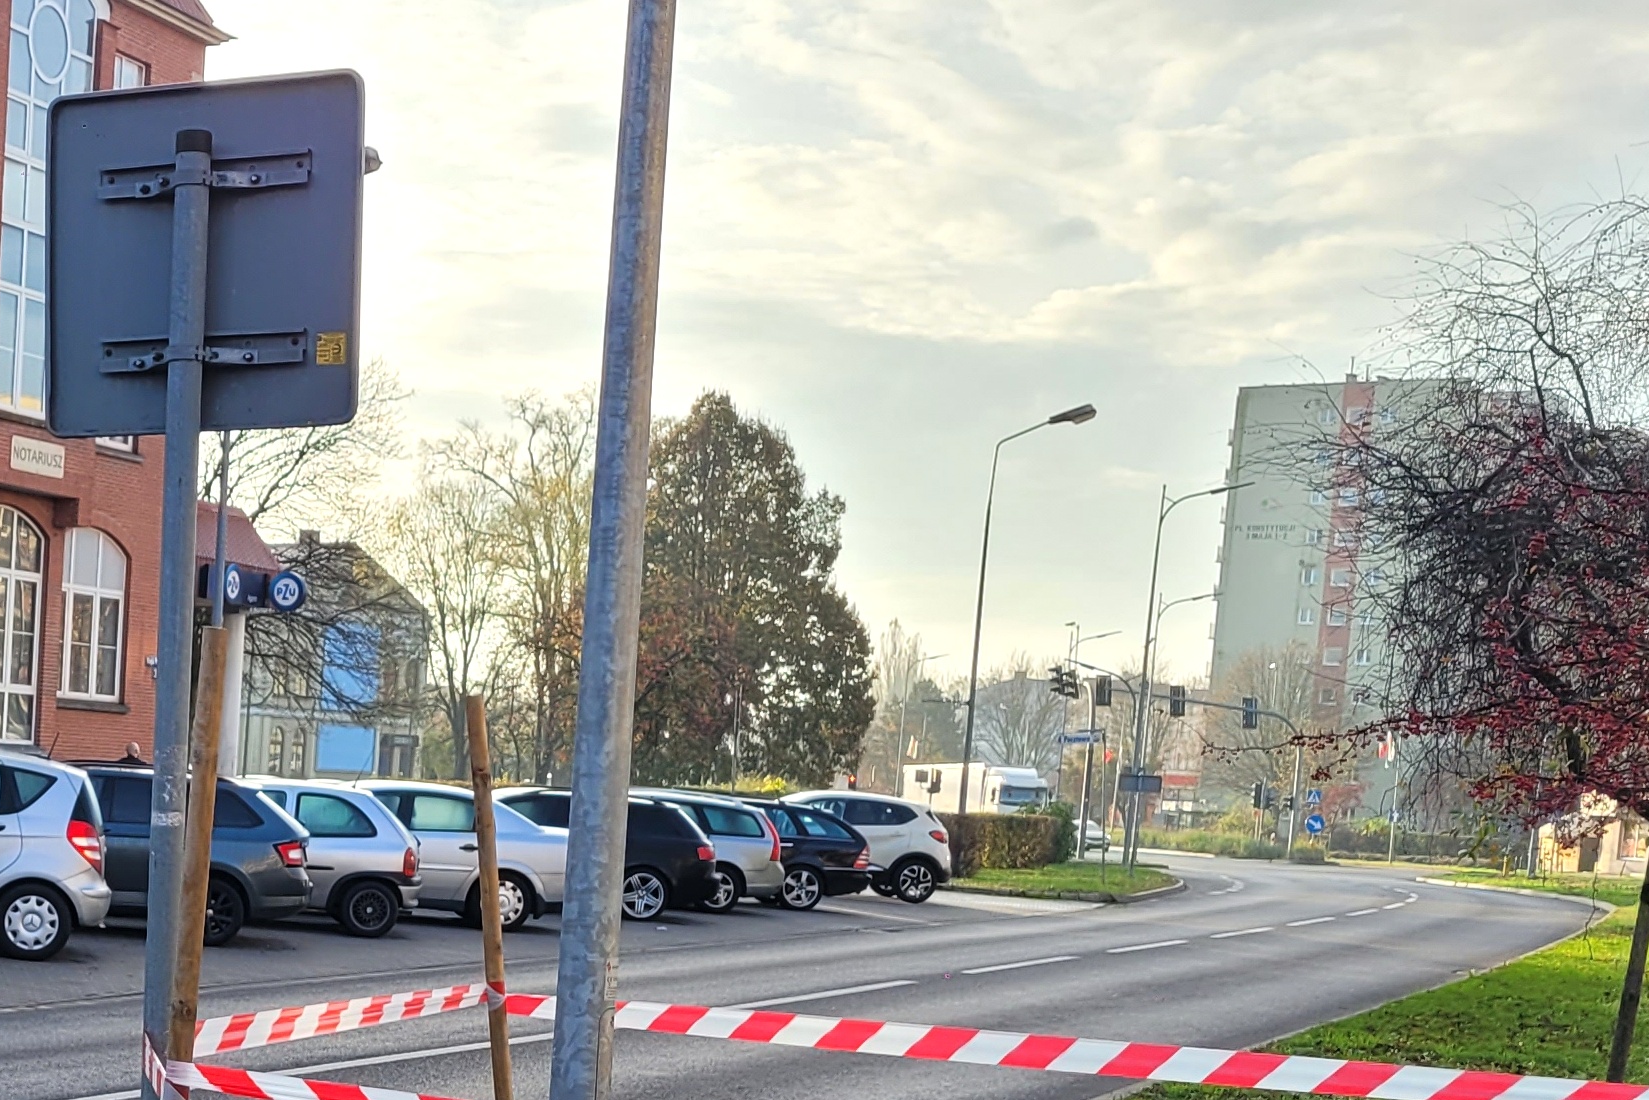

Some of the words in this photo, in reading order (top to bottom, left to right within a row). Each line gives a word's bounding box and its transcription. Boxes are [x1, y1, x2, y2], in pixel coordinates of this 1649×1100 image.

[13, 445, 63, 469] NOTARIUSZ
[228, 576, 239, 594] PZU
[276, 583, 296, 601] PZU
